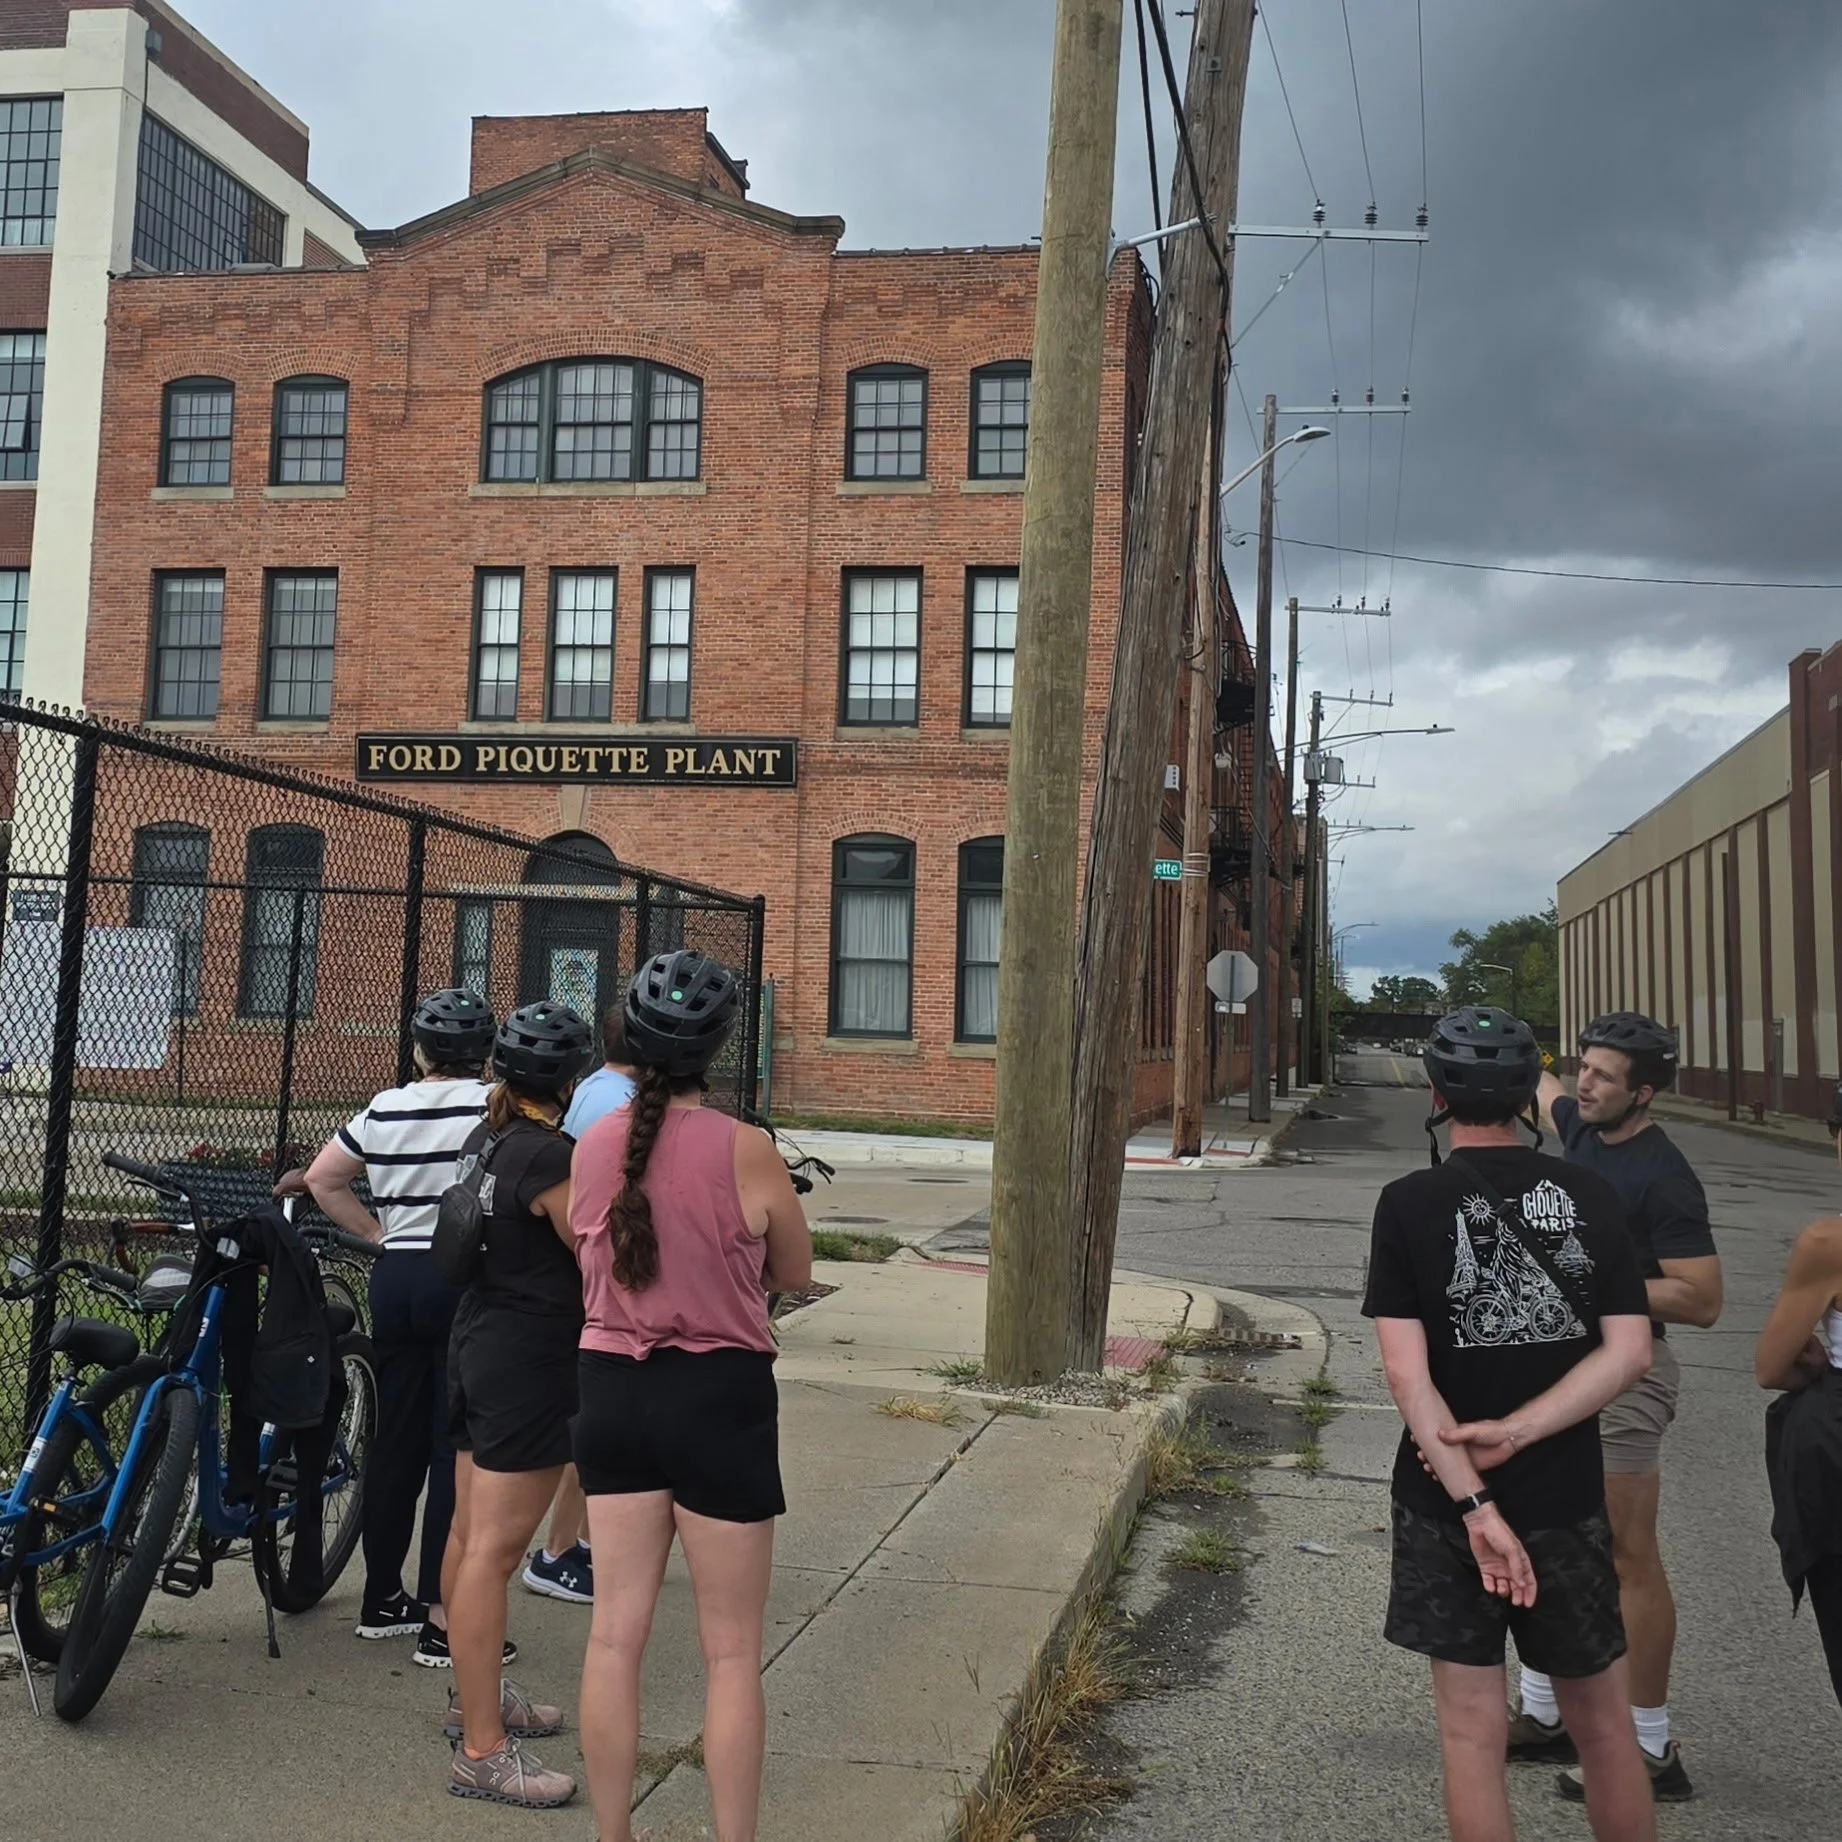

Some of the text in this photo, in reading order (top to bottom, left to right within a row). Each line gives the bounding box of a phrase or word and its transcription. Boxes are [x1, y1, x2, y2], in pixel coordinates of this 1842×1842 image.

[368, 745, 781, 776] FORD PIQUETTE PLANT
[1531, 1217, 1576, 1232] PARIS
